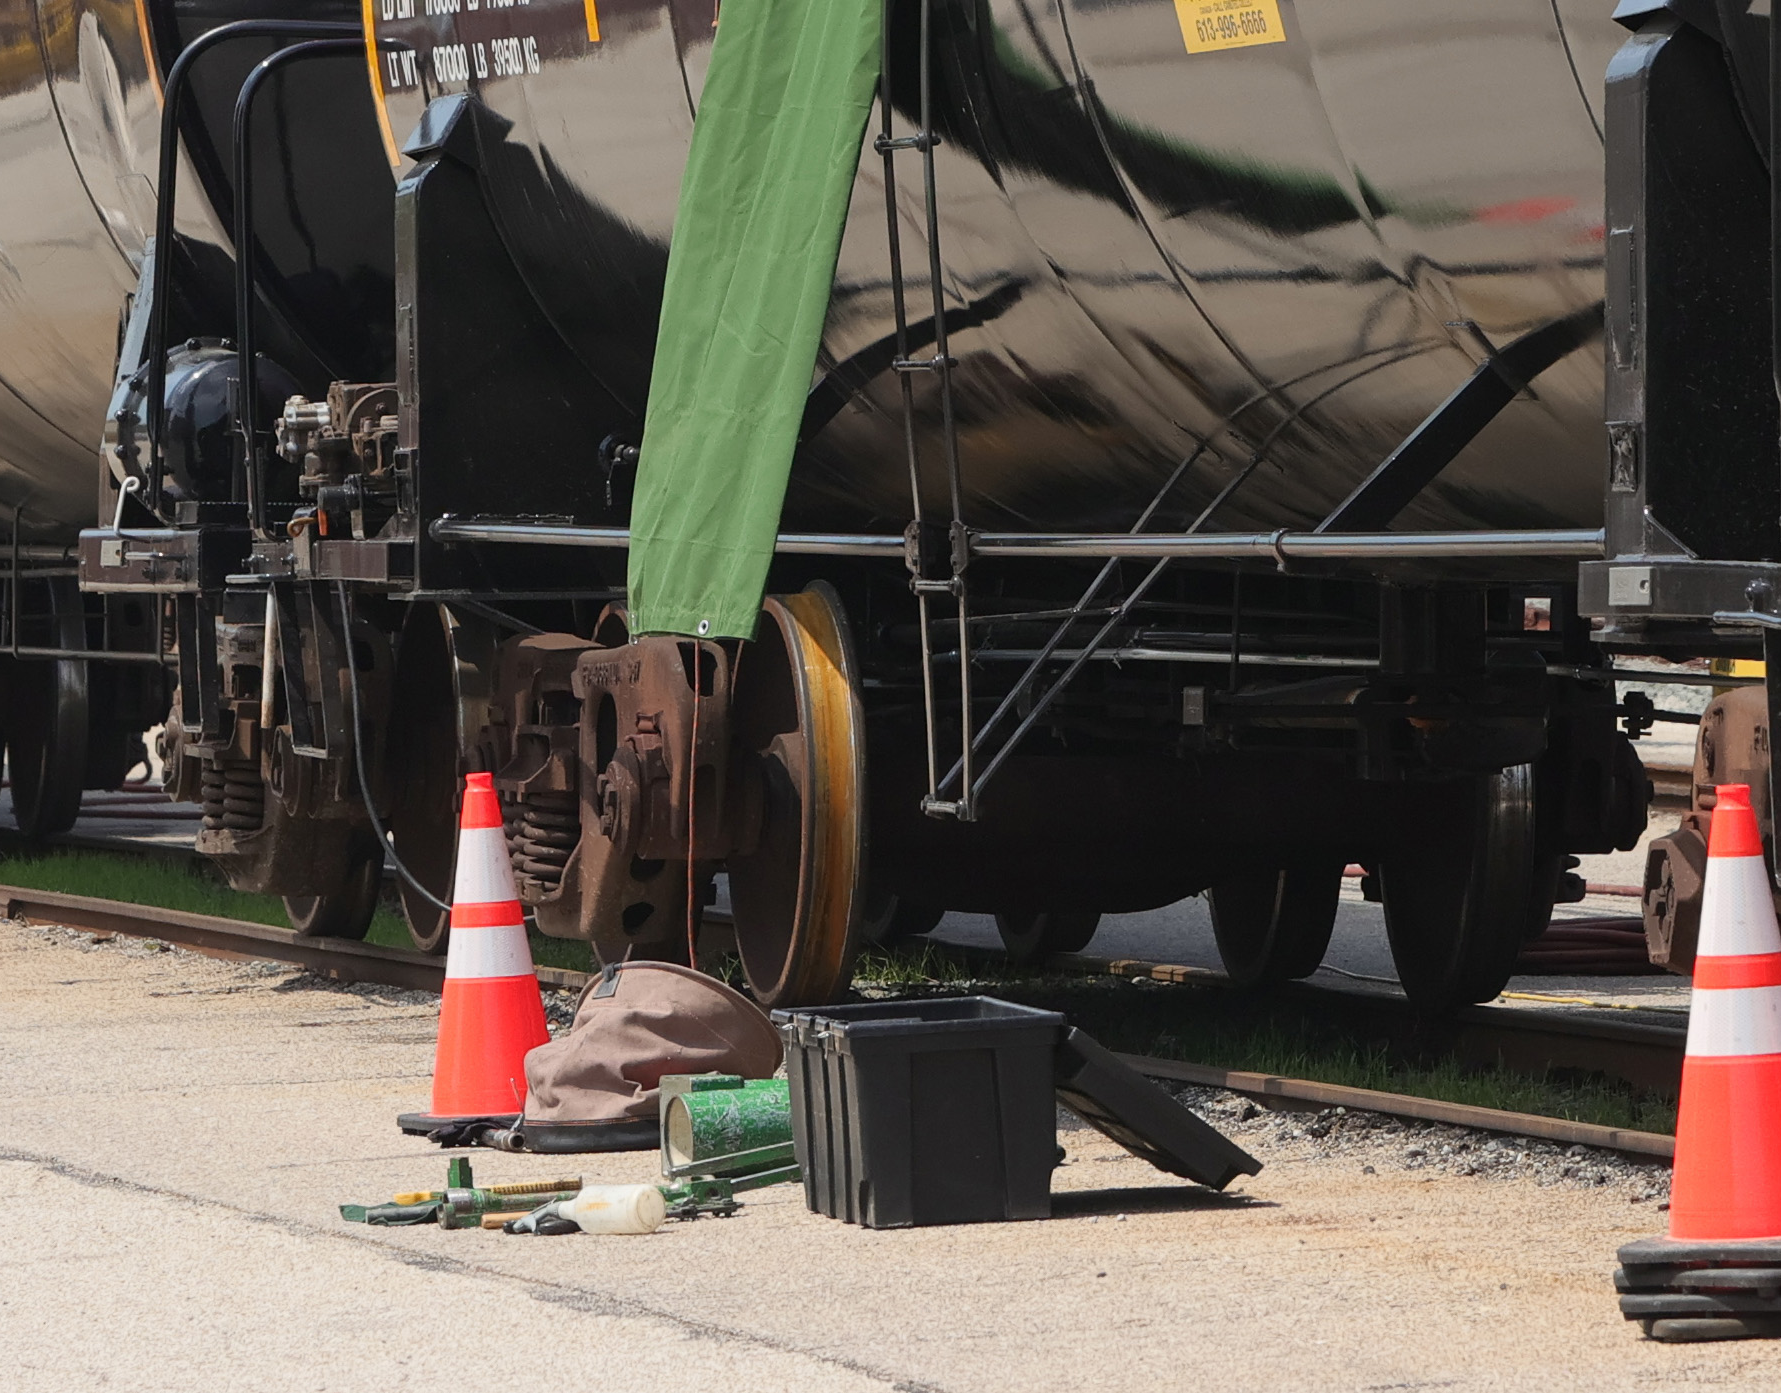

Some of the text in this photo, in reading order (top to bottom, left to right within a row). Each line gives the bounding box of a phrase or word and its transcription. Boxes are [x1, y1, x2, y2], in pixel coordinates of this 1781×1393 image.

[1195, 9, 1266, 42] 613-996-6666
[386, 51, 401, 88] LT
[400, 49, 418, 86] WT
[433, 43, 469, 83] 87000
[472, 41, 488, 79] LB
[523, 36, 540, 74] KG
